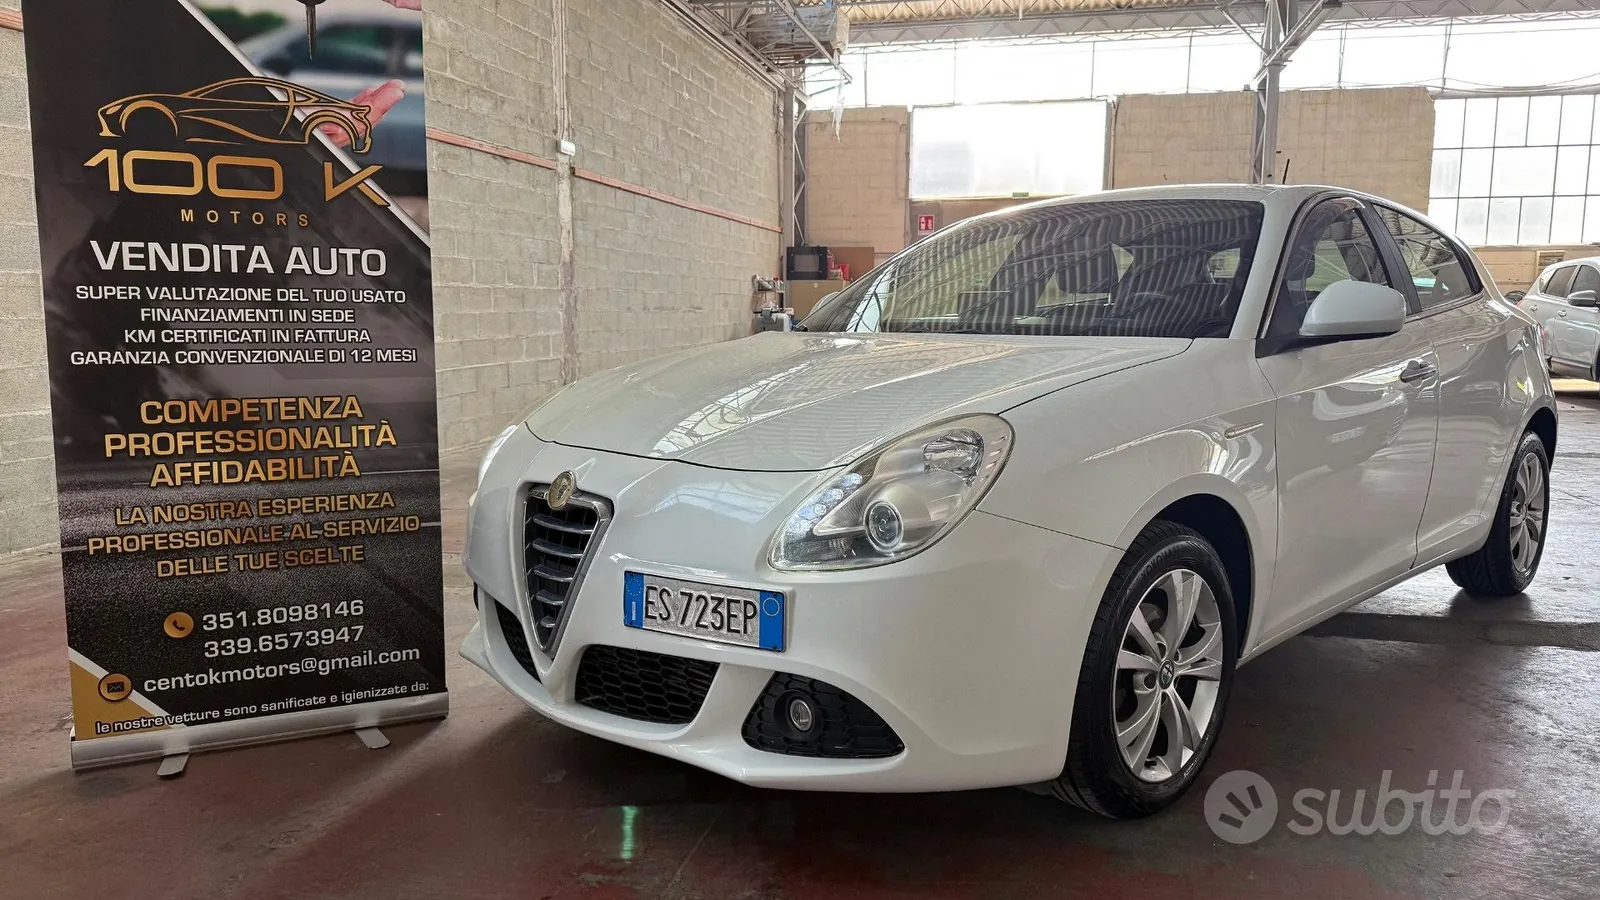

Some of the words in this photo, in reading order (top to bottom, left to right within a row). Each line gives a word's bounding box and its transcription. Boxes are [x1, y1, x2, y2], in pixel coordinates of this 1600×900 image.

[83, 148, 284, 201] 100
[323, 161, 391, 207] K
[180, 209, 309, 227] MOTORS
[90, 240, 275, 275] VENDITA
[285, 246, 387, 277] AUTO
[76, 285, 141, 300] SUPER
[145, 286, 272, 302] VALUTAZIONE
[276, 288, 309, 302] DEL
[313, 289, 347, 303] TUO
[351, 290, 406, 304] USATO
[140, 308, 284, 323] FINANZIAMENTI
[288, 309, 307, 323] IN
[311, 309, 355, 323] SEDE
[124, 329, 156, 344] KM
[161, 329, 267, 344] CERTIFICATI
[271, 329, 291, 343] IN
[295, 329, 371, 343] FATTURA
[70, 350, 171, 366] GARANZIA
[175, 350, 324, 365] CONVENZIONALE
[329, 350, 345, 363] DI
[350, 350, 372, 363] 12
[377, 349, 417, 363] MESI
[140, 396, 364, 425] COMPETENZA
[104, 419, 397, 457] PROFESSIONALITÀ
[150, 450, 361, 487] AFFIDABILITÀ
[116, 506, 147, 525] LA
[153, 500, 253, 523] NOSTRA
[258, 492, 395, 517] ESPERIENZA
[88, 525, 285, 555] PROFESSIONALE
[289, 521, 319, 540] AL
[322, 515, 421, 538] SERVIZIO
[157, 555, 229, 578] DELLE
[234, 551, 279, 572] TUE
[284, 545, 364, 567] SCELTE
[202, 600, 364, 631] 351.8098146
[645, 585, 671, 622] ES
[680, 591, 757, 634] 723EP
[204, 625, 365, 658] 339.6573947
[143, 648, 420, 692] centokmotors@gmail.com
[96, 721, 110, 734] le
[114, 718, 163, 732] nostre
[167, 709, 220, 725] vetture
[224, 703, 257, 718] sono
[260, 694, 327, 713] sanificate
[330, 694, 338, 703] e
[341, 683, 408, 703] igienizzate
[411, 681, 430, 692] da:
